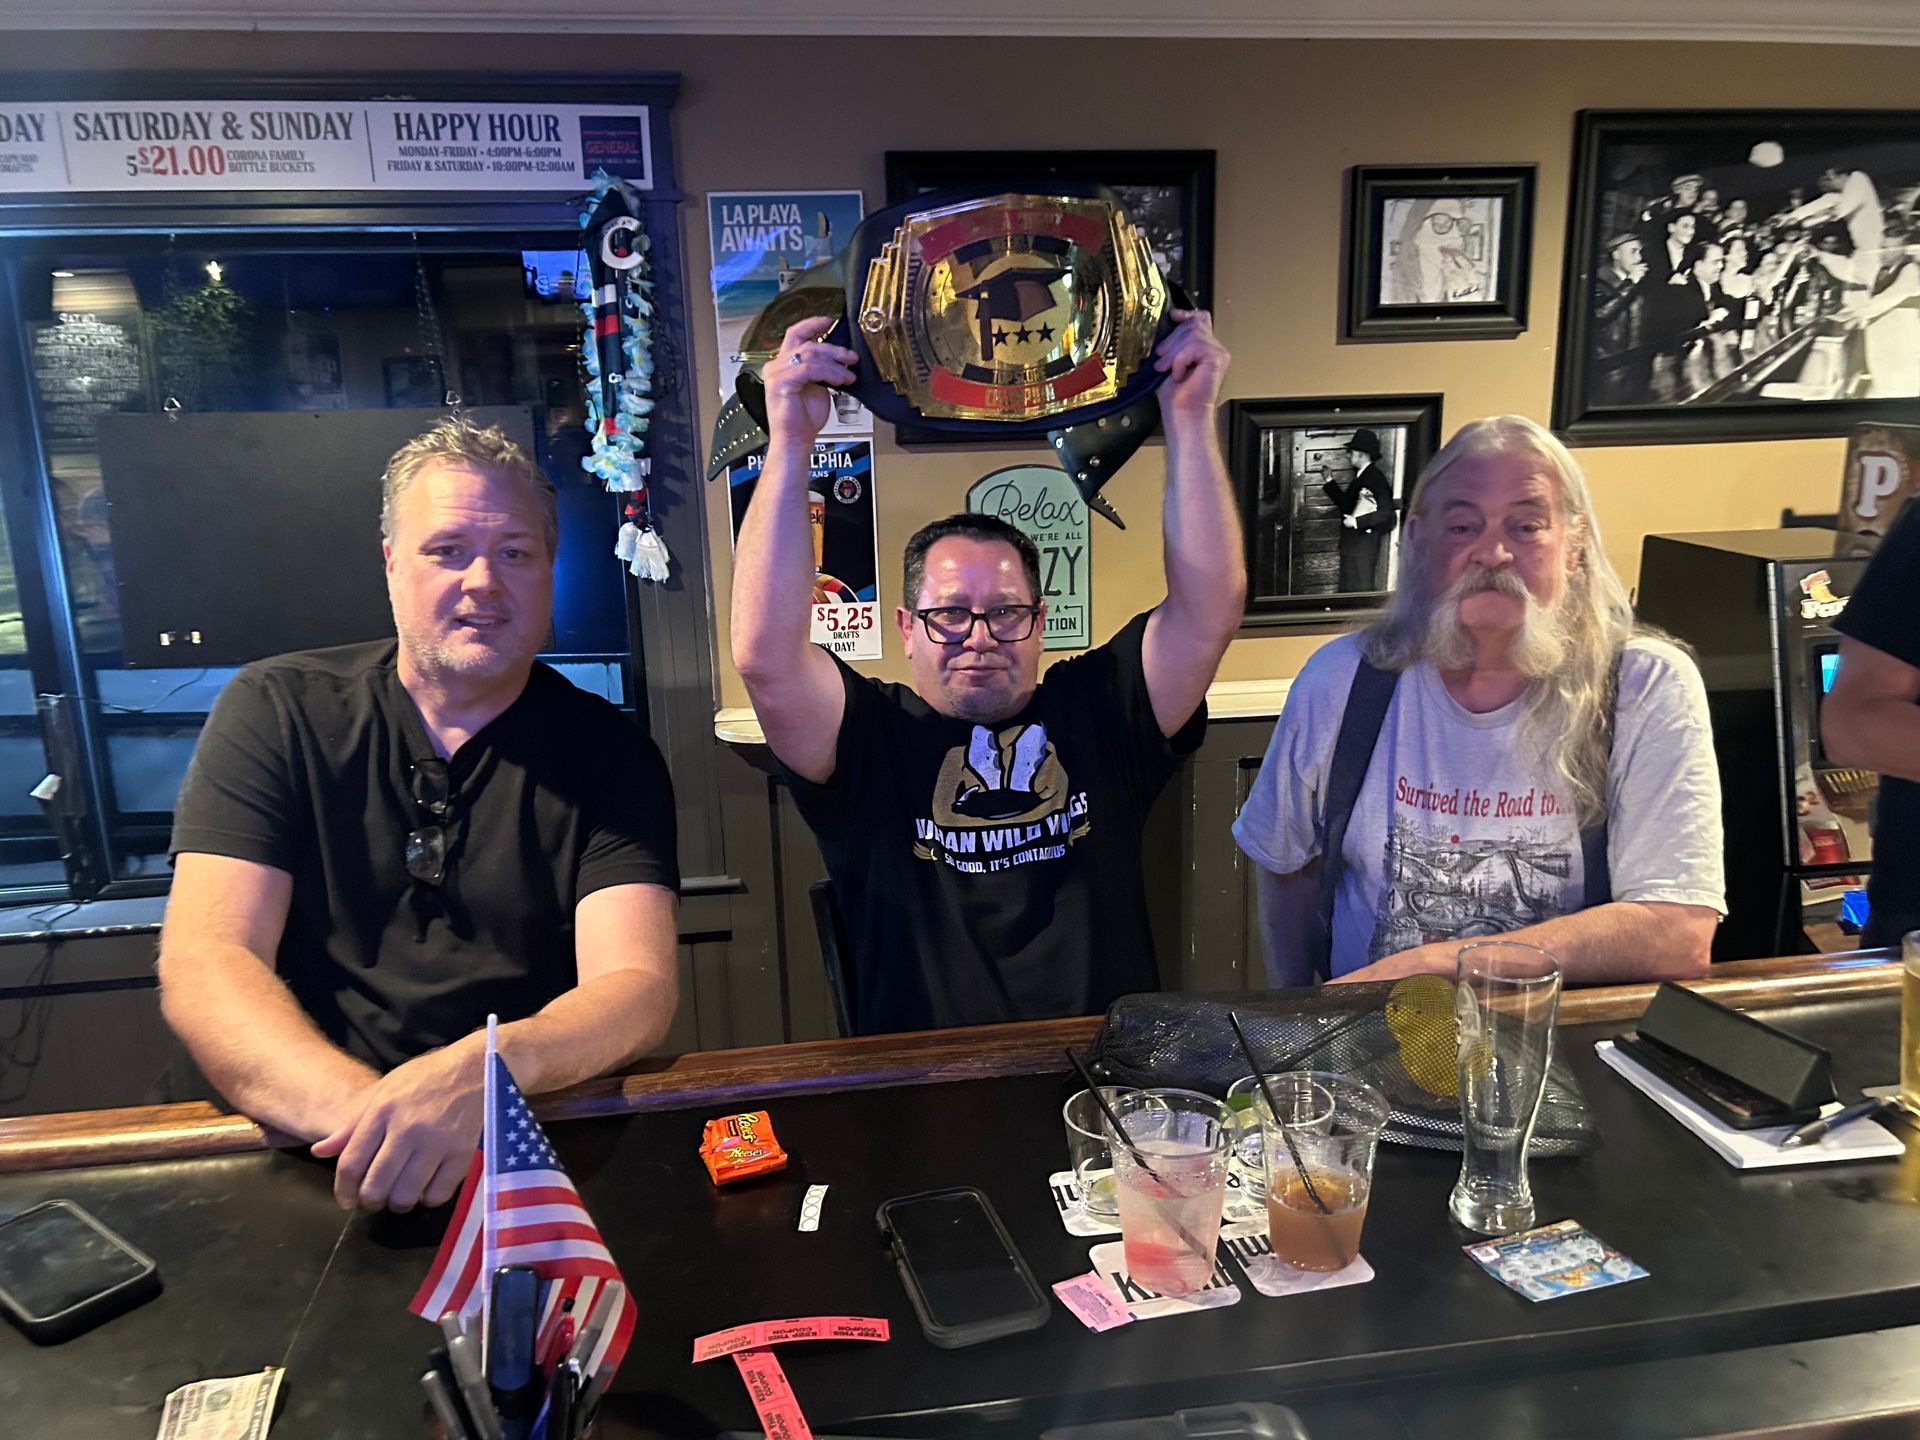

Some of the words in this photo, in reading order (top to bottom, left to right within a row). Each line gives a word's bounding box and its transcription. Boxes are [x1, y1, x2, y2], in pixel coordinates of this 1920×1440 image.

[74, 112, 213, 141] SATURDAY
[221, 111, 245, 140] &
[251, 111, 353, 140] SUNDAY
[393, 112, 481, 142] HAPPY
[489, 113, 562, 142] HOUR
[126, 155, 138, 176] 5
[138, 145, 225, 175] $21.00
[227, 150, 268, 161] CORONA
[270, 150, 305, 161] FAMILY
[228, 162, 268, 173] BOTTLE
[269, 162, 316, 173] BUCKETS
[387, 160, 421, 171] FRIDAY
[424, 160, 433, 171] &
[434, 160, 484, 172] SATURDAY
[722, 205, 745, 225] LA
[748, 204, 802, 224] PLAYA
[720, 226, 803, 252] AWAITS
[980, 480, 1084, 529] Relax
[1030, 532, 1059, 541] WE'RE
[1065, 532, 1082, 540] ALL
[817, 606, 873, 631] $5.25
[833, 631, 860, 639] DRAFTS
[834, 641, 856, 652] DAY!
[1396, 775, 1459, 816] Survived
[1463, 788, 1490, 817] the
[1494, 788, 1535, 818] Road
[981, 823, 1042, 853] WILD
[1045, 792, 1088, 836] WIGS
[956, 860, 987, 874] GOOD,
[990, 857, 1010, 872] IT'S
[767, 1333, 790, 1341] THIS
[772, 1326, 812, 1335] COUPON
